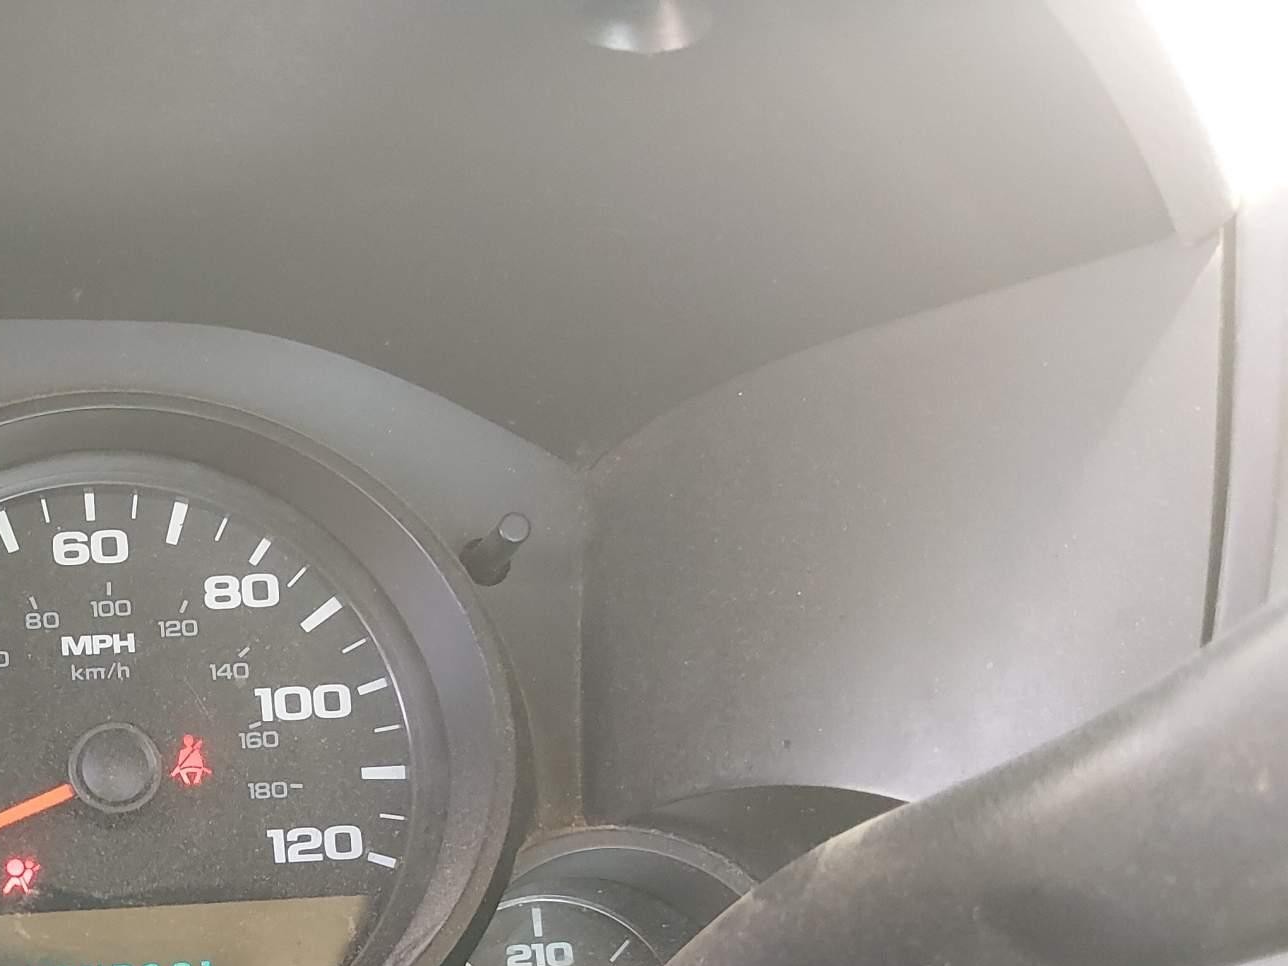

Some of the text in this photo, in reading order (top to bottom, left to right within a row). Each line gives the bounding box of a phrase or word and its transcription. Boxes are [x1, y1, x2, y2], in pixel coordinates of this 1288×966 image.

[51, 529, 129, 566] 60
[204, 573, 280, 610] 80
[90, 600, 132, 618] 100
[25, 611, 60, 630] 80
[157, 619, 199, 638] 120
[61, 633, 136, 656] MPH
[71, 664, 131, 682] km/h
[209, 662, 251, 680] 140
[254, 685, 352, 722] 100
[238, 730, 280, 749] 160
[247, 782, 289, 799] 180
[266, 826, 363, 864] 120
